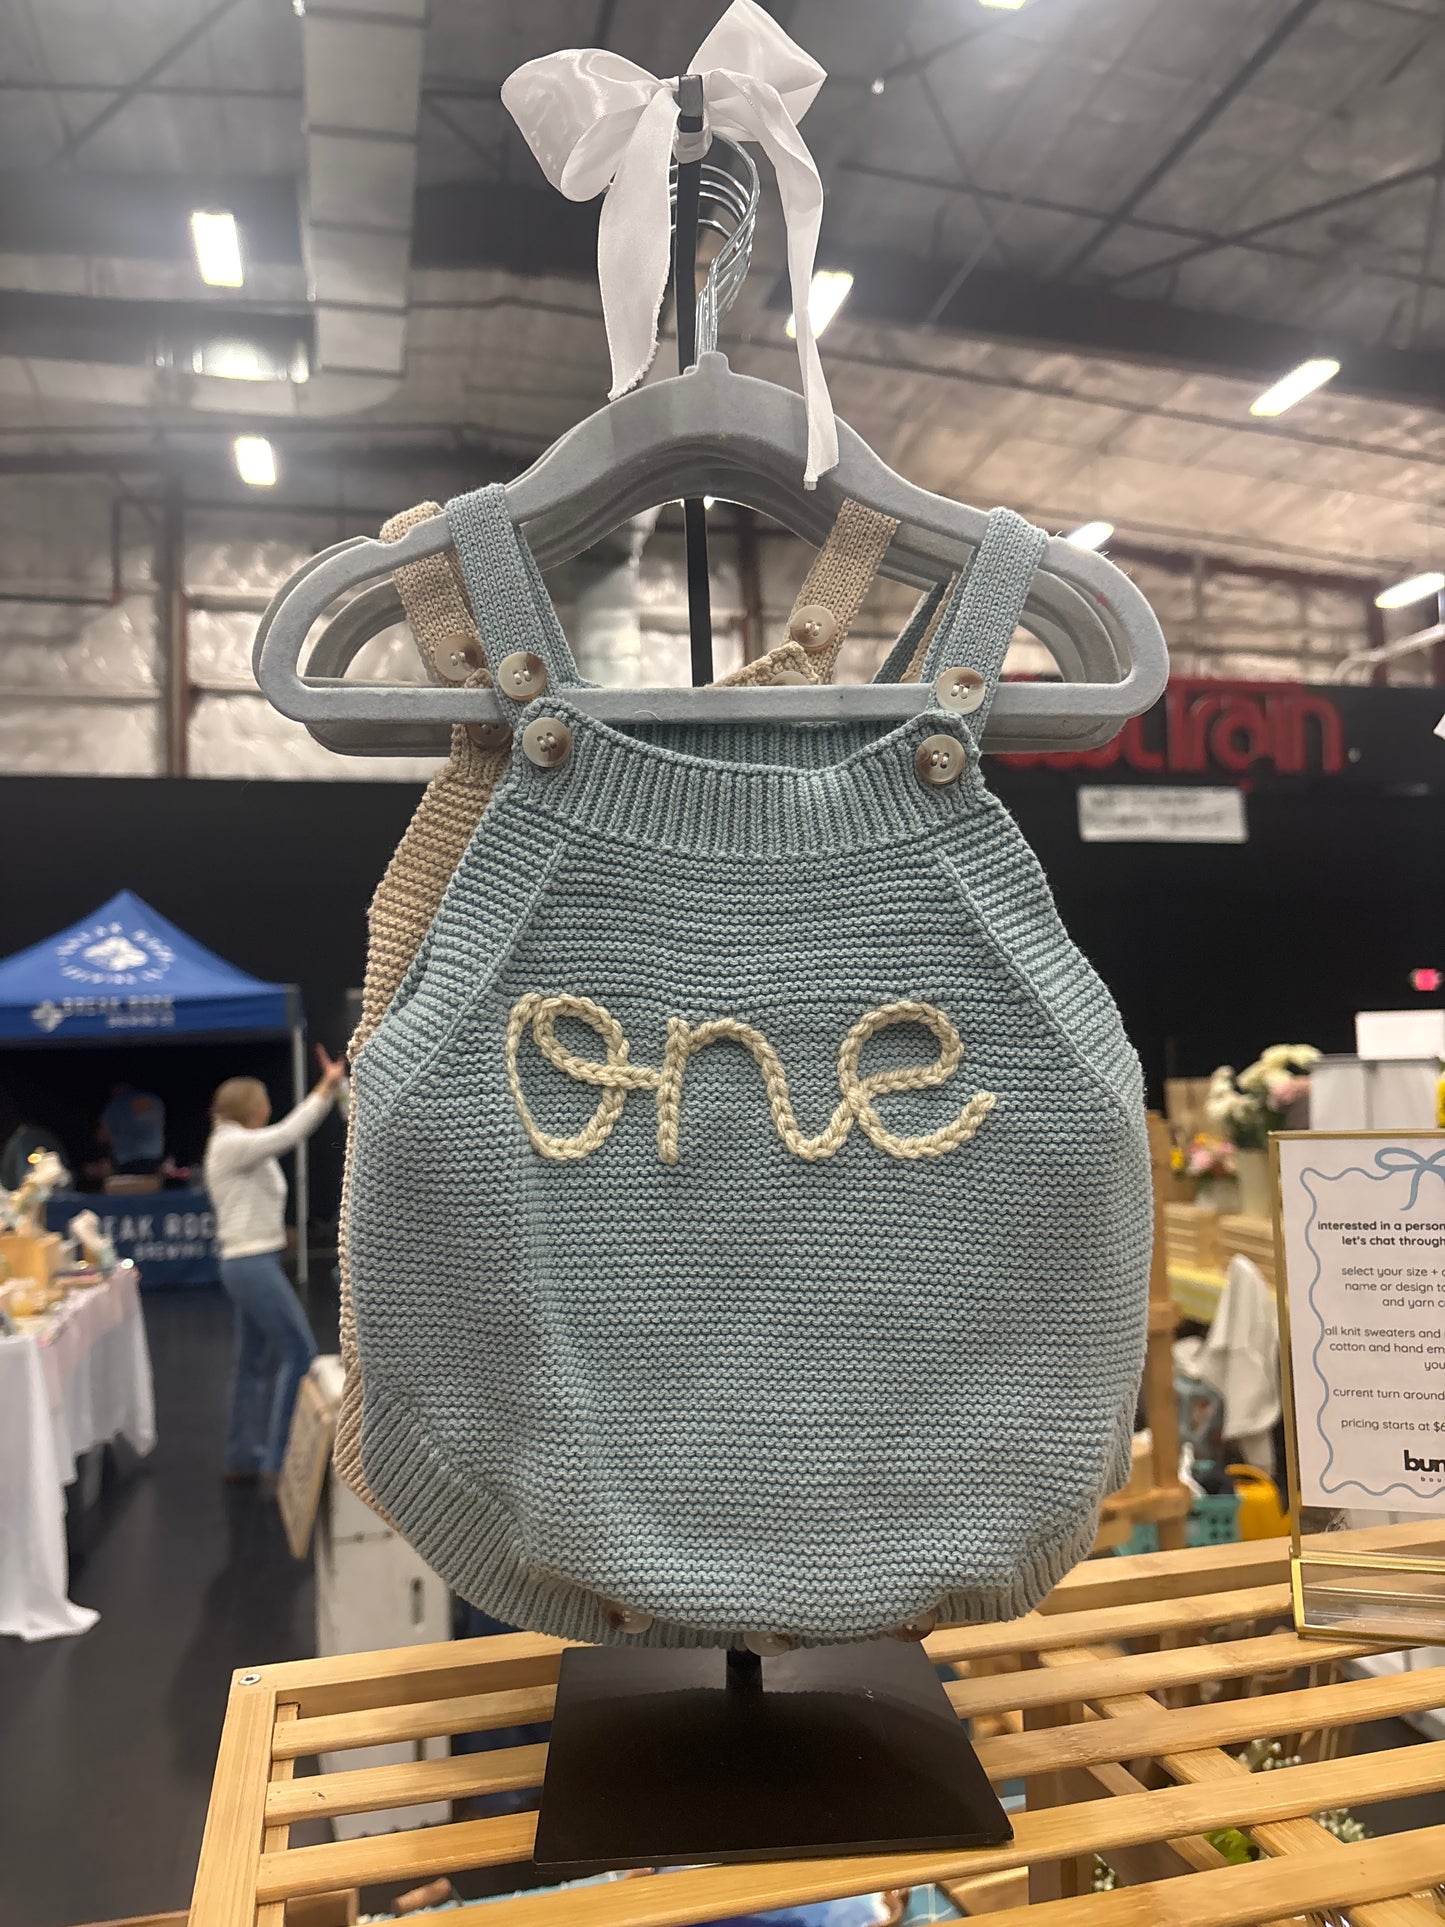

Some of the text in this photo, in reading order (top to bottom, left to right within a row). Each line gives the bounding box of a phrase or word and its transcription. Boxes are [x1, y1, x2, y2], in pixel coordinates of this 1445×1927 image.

[506, 992, 998, 1165] one
[1317, 1221, 1377, 1231] interested
[1380, 1221, 1391, 1231] in
[1394, 1223, 1402, 1231] a
[1342, 1236, 1445, 1249] let's chat through
[1341, 1266, 1374, 1276] select
[1377, 1268, 1403, 1278] your
[1406, 1267, 1428, 1277] size
[1345, 1282, 1377, 1291] name
[1380, 1283, 1392, 1291] or
[1395, 1282, 1434, 1294] design
[1382, 1297, 1405, 1307] and
[1408, 1299, 1435, 1309] yarn
[1325, 1326, 1441, 1338] all knit sweaters and
[1329, 1342, 1366, 1352] cotton
[1368, 1343, 1391, 1352] and
[1394, 1343, 1424, 1353] hand
[1333, 1388, 1445, 1400] current turn around
[1341, 1418, 1380, 1431] pricing
[1382, 1420, 1415, 1431] starts
[1417, 1422, 1430, 1431] at
